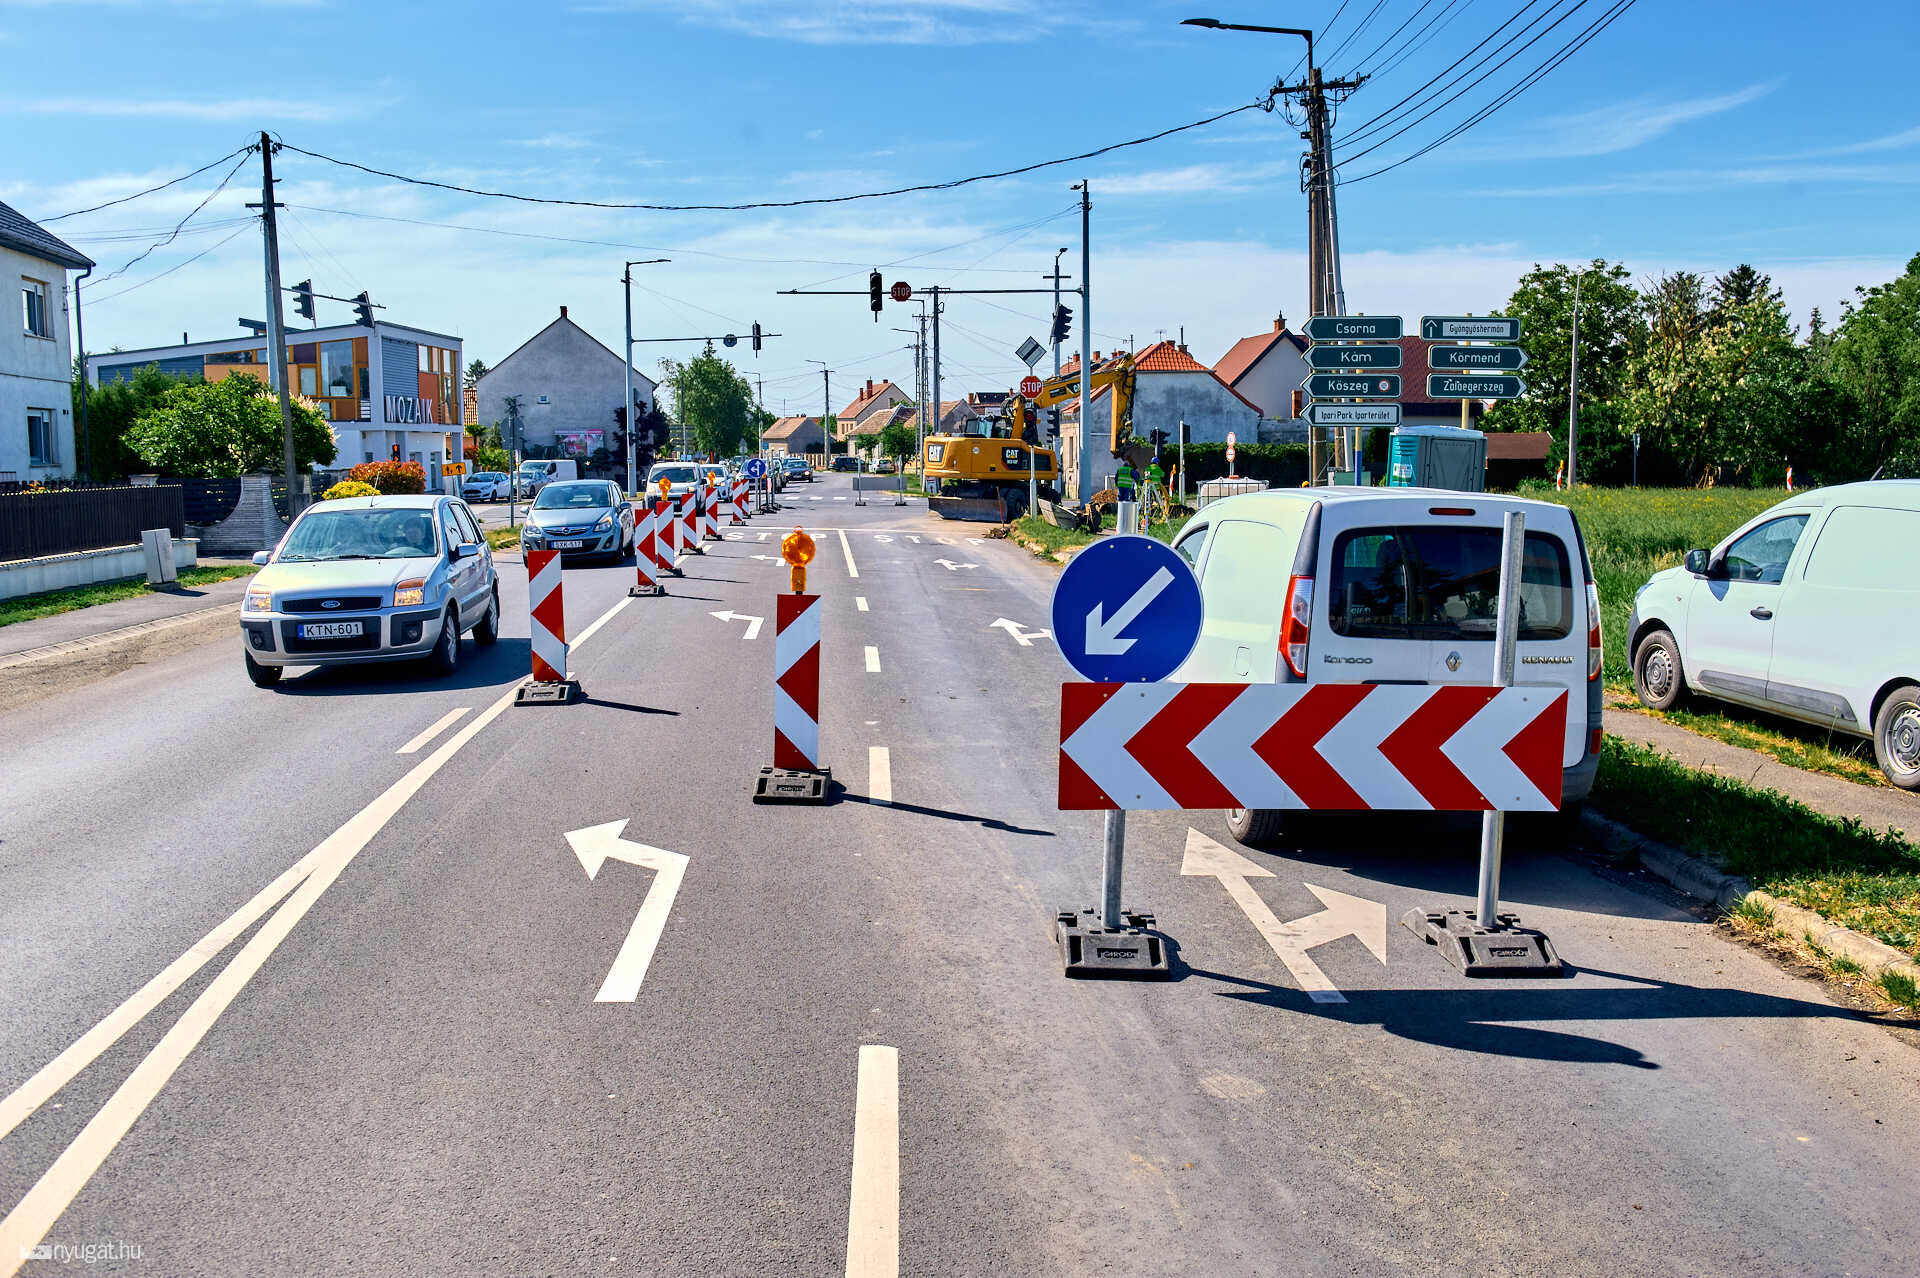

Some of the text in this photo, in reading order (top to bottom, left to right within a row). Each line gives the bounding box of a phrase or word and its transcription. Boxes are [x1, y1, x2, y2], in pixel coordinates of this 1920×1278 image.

[892, 287, 911, 297] STOP
[1335, 323, 1376, 334] Csorna
[1340, 350, 1372, 362] Kám
[1449, 351, 1501, 363] Körmend
[1021, 382, 1042, 393] STOP
[386, 395, 433, 424] MOZAIK
[929, 446, 942, 462] CAT
[1006, 449, 1018, 459] CAT
[724, 532, 828, 541] STP
[305, 623, 361, 637] KTN-601
[1522, 656, 1575, 664] RENAULT
